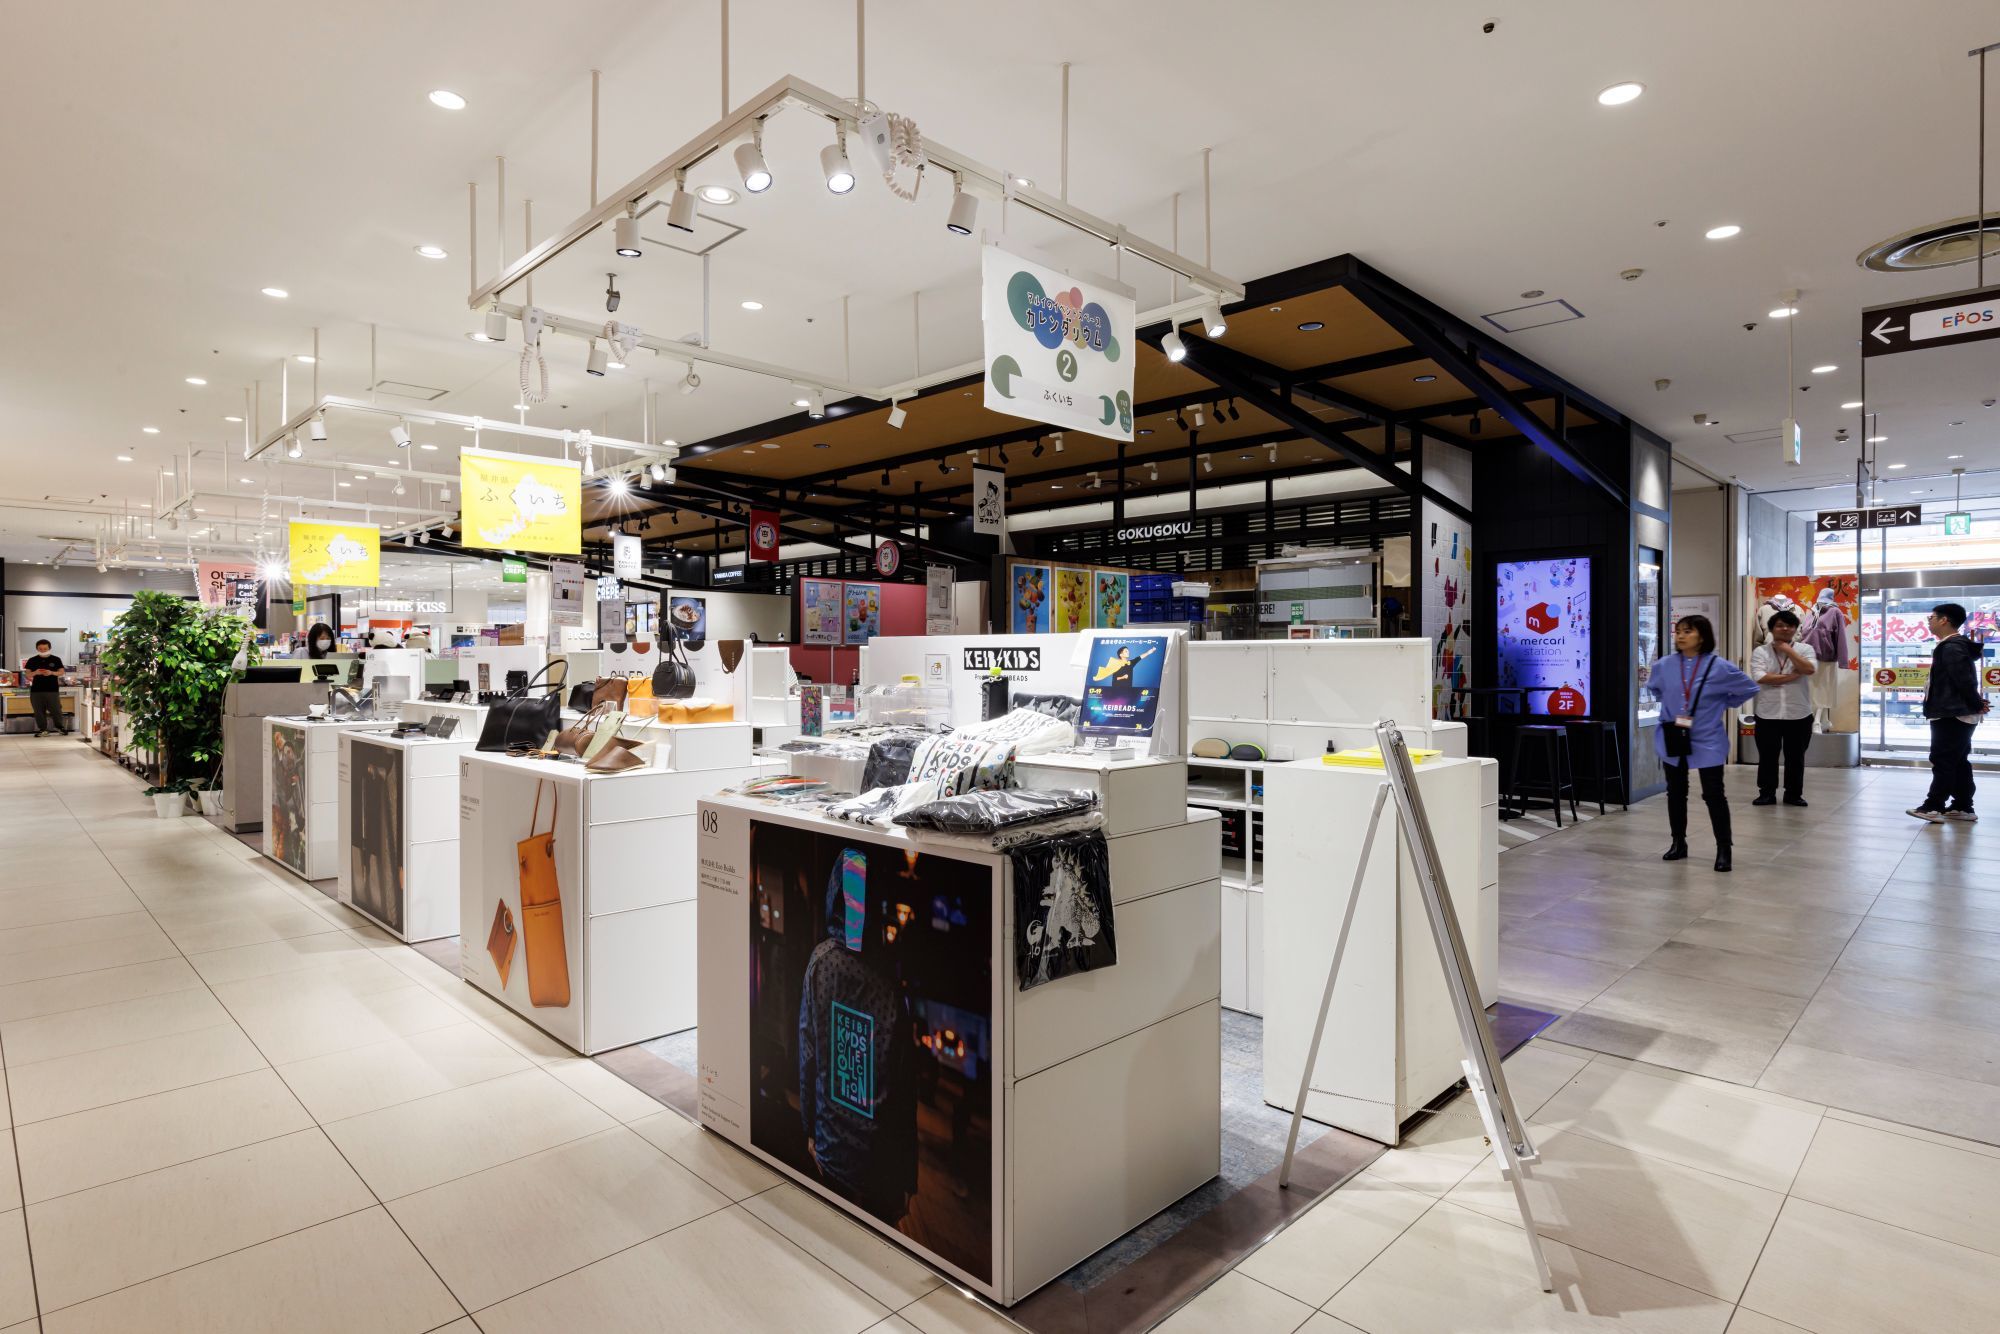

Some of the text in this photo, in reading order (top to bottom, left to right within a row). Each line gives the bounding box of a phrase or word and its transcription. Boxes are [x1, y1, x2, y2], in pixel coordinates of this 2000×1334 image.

[1026, 307, 1102, 348] カレンダリウム
[1942, 310, 1994, 328] EPOS
[1062, 353, 1072, 378] 2
[1043, 389, 1073, 406] ふくいち
[480, 487, 566, 509] ふくいち
[1117, 521, 1191, 541] GOKUGOKU
[303, 543, 369, 557] ふくいち
[386, 602, 447, 612] THE KISS
[1520, 636, 1565, 645] mercari
[1523, 647, 1562, 656] station
[1103, 704, 1136, 712] KEIBEADS
[1558, 700, 1574, 710] 2F
[702, 809, 718, 834] 08
[837, 1013, 867, 1035] KEIBI
[838, 1027, 867, 1053] KIDS
